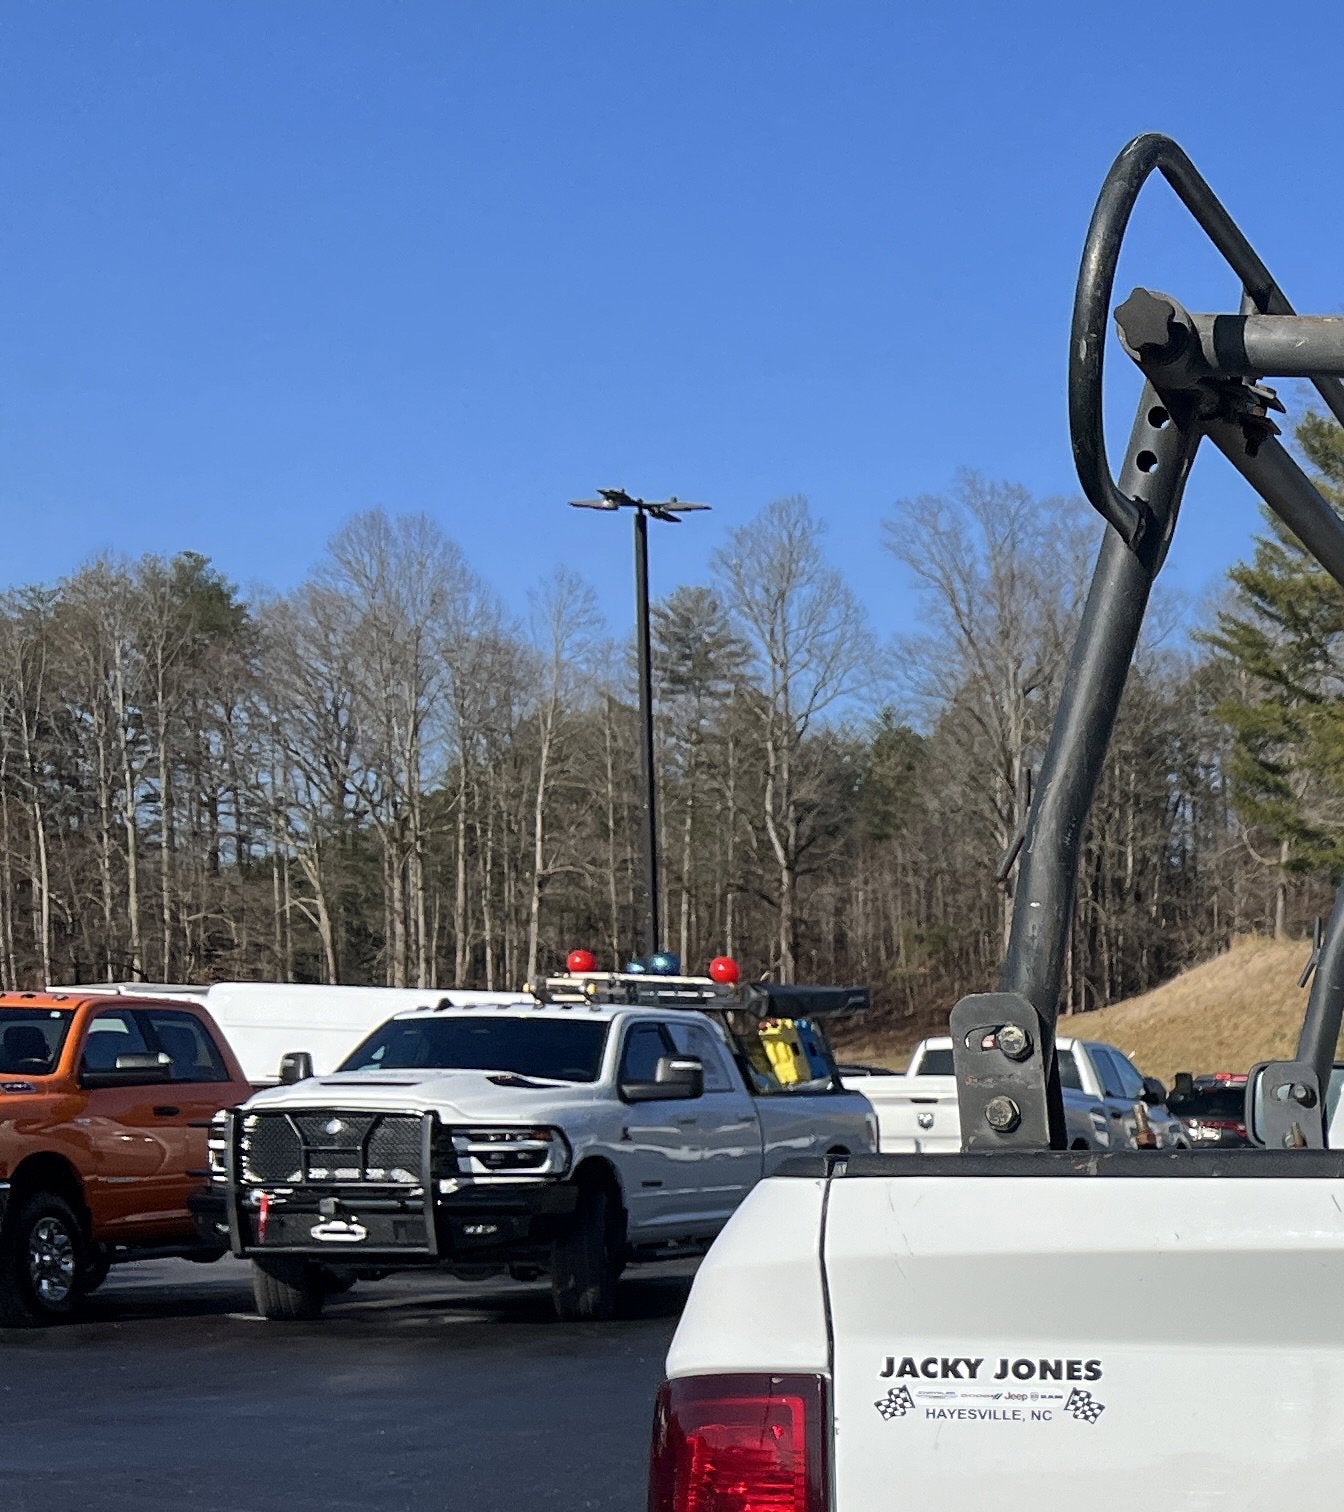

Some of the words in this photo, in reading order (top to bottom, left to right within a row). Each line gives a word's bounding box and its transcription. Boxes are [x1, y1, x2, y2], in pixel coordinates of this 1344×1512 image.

[880, 1356, 984, 1379] JACKY
[993, 1358, 1103, 1381] JONES
[1004, 1392, 1028, 1401] Jeep
[926, 1408, 1026, 1422] HAYESVILLE,
[1031, 1410, 1053, 1421] NC
